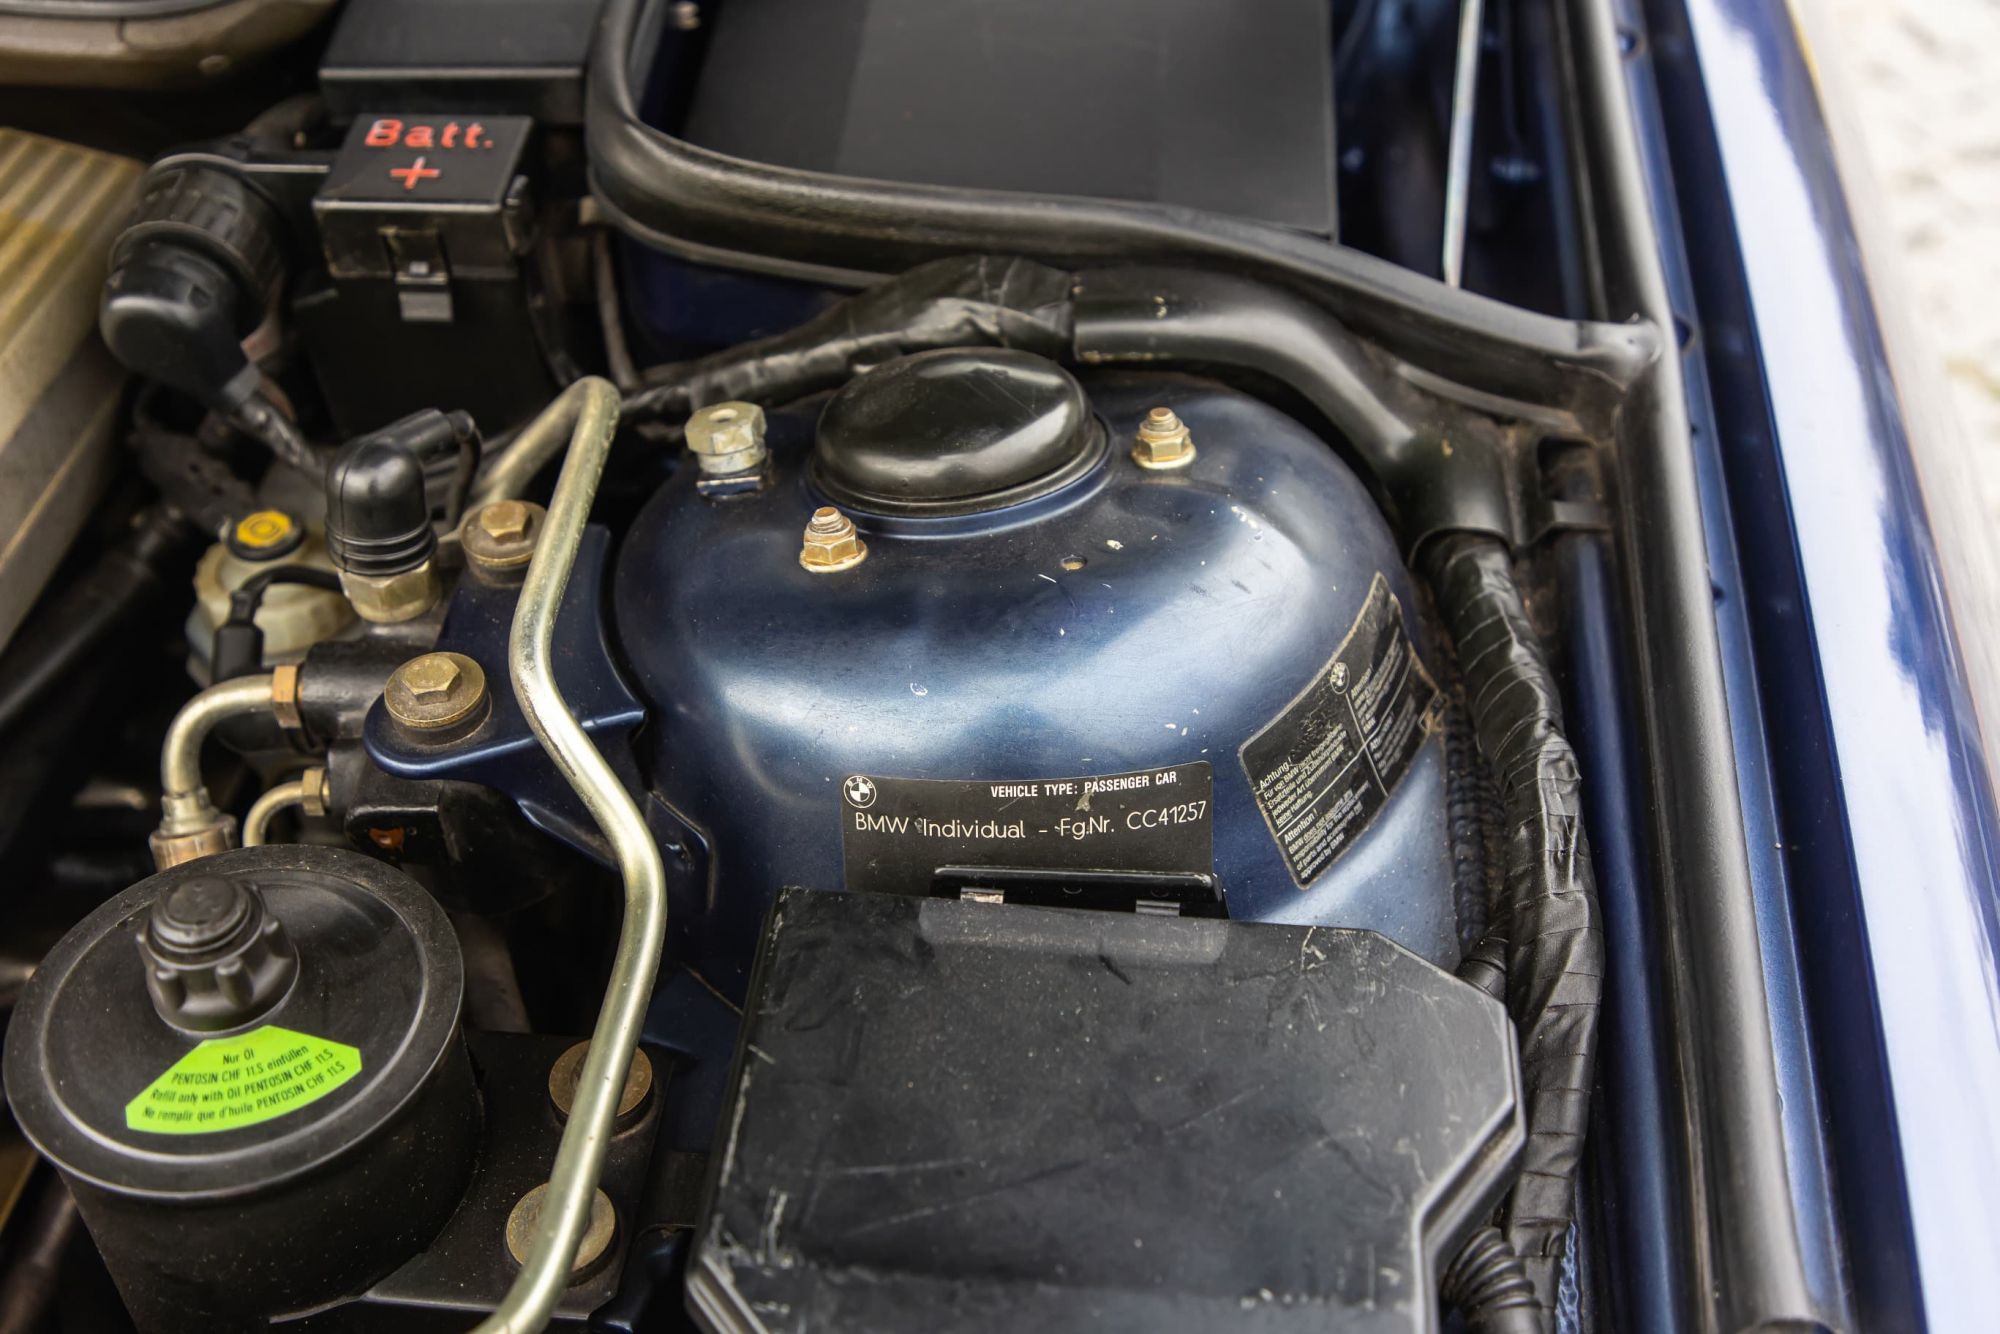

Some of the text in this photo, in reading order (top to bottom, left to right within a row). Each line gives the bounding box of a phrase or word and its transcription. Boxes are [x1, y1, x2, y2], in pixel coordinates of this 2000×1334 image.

[364, 118, 494, 149] Batt.
[990, 771, 1177, 798] VEHICLE TYPE: PASSENGER CAR
[1259, 761, 1289, 790] Achtung
[1264, 788, 1273, 800] Für
[1274, 780, 1285, 791] von
[1284, 765, 1299, 782] BMW
[1268, 780, 1296, 808] Ersatzteile
[1294, 770, 1306, 784] und
[1296, 783, 1306, 795] Art
[855, 812, 909, 834] BMW
[923, 818, 1026, 838] Individual
[1060, 815, 1115, 840] Fg.Nr.
[1126, 800, 1207, 830] CC41257
[1276, 809, 1291, 826] keine
[1284, 813, 1315, 844] Attention
[1289, 837, 1304, 854] BMW
[1303, 826, 1316, 841] does
[1315, 816, 1326, 829] not
[1293, 827, 1326, 863] responsibility
[1325, 819, 1334, 831] for
[1333, 810, 1342, 822] the
[1296, 860, 1303, 871] of
[1302, 849, 1317, 866] parts
[1315, 838, 1327, 852] and
[1300, 833, 1345, 879] approved by BMW
[223, 1053, 240, 1064] Nur
[151, 1089, 176, 1101] Refill
[178, 1092, 198, 1104] only
[202, 1090, 223, 1102] with
[227, 1086, 240, 1099] Oil
[243, 1070, 293, 1096] PENTOSIN
[293, 1060, 312, 1076] CHF
[171, 1071, 218, 1085] PENTOSIN
[221, 1068, 240, 1082] CHF
[197, 1111, 215, 1122] que
[256, 1084, 305, 1109] PENTOSIN
[305, 1072, 325, 1089] CHF
